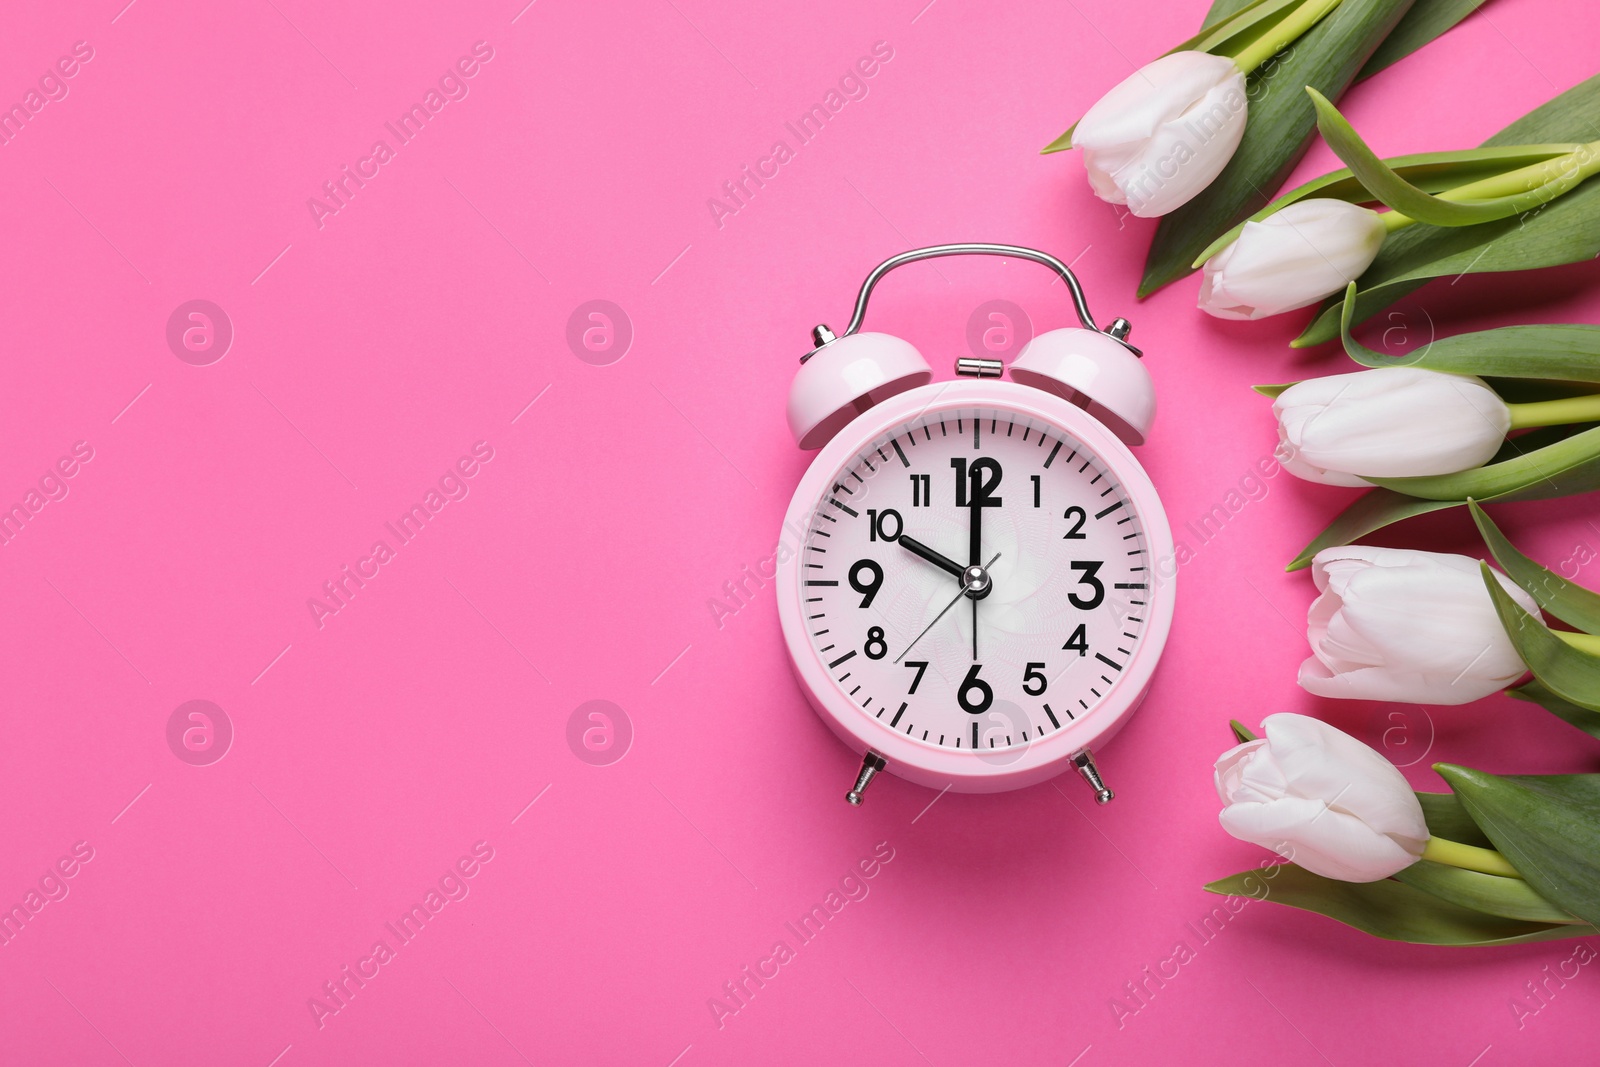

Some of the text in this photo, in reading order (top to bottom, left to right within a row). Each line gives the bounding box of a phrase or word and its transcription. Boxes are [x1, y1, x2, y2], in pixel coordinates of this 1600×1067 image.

[909, 474, 931, 507] 11
[950, 457, 1002, 507] 12
[1030, 475, 1041, 508] 1
[867, 509, 903, 542] 10
[1063, 506, 1086, 539] 2
[848, 558, 884, 608] 9
[1067, 560, 1105, 610] 3
[864, 626, 888, 660] 8
[1062, 624, 1089, 656] 4
[904, 661, 929, 695] 7
[957, 664, 994, 714] 6
[1022, 662, 1048, 696] 5
